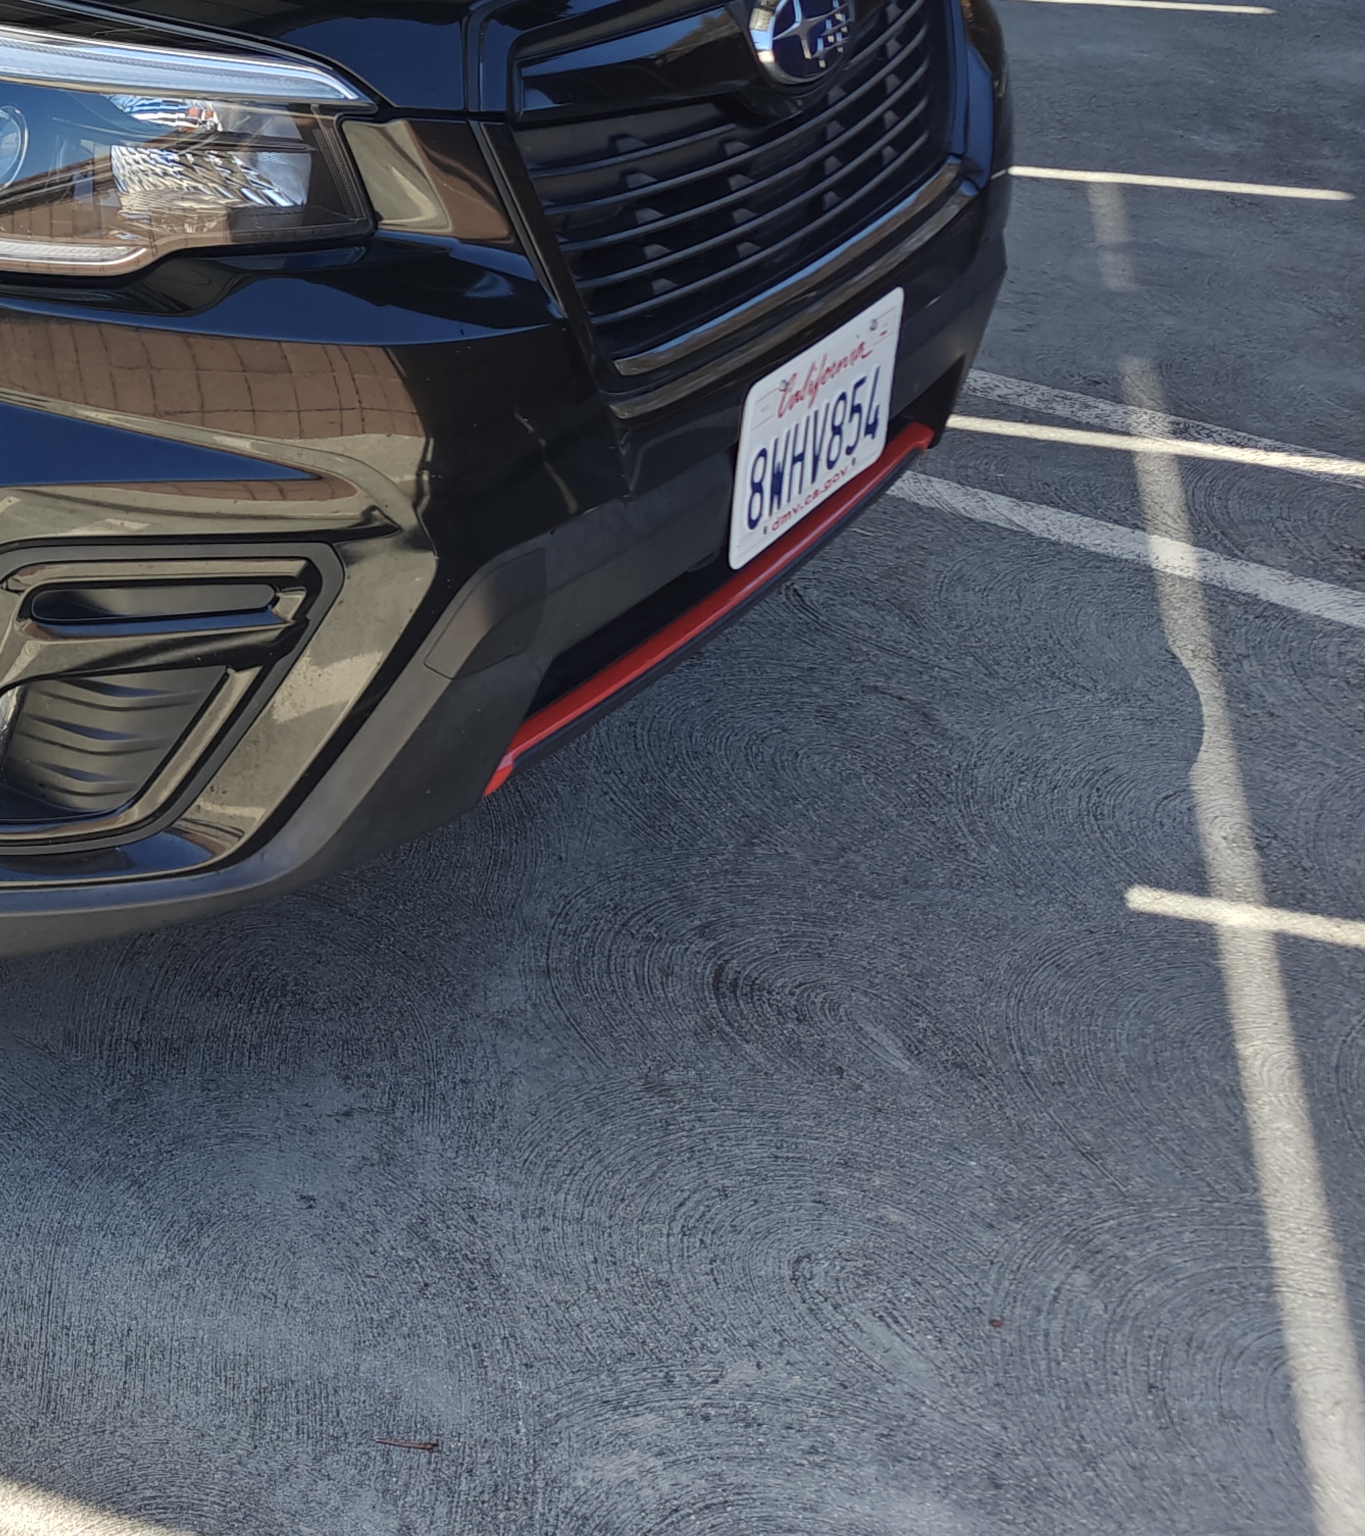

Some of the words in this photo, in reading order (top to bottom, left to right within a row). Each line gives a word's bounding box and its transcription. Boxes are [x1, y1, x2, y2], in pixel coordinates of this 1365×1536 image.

[777, 340, 873, 419] California
[746, 365, 882, 531] 8WHV854
[771, 465, 849, 532] dmv.ca.gov
